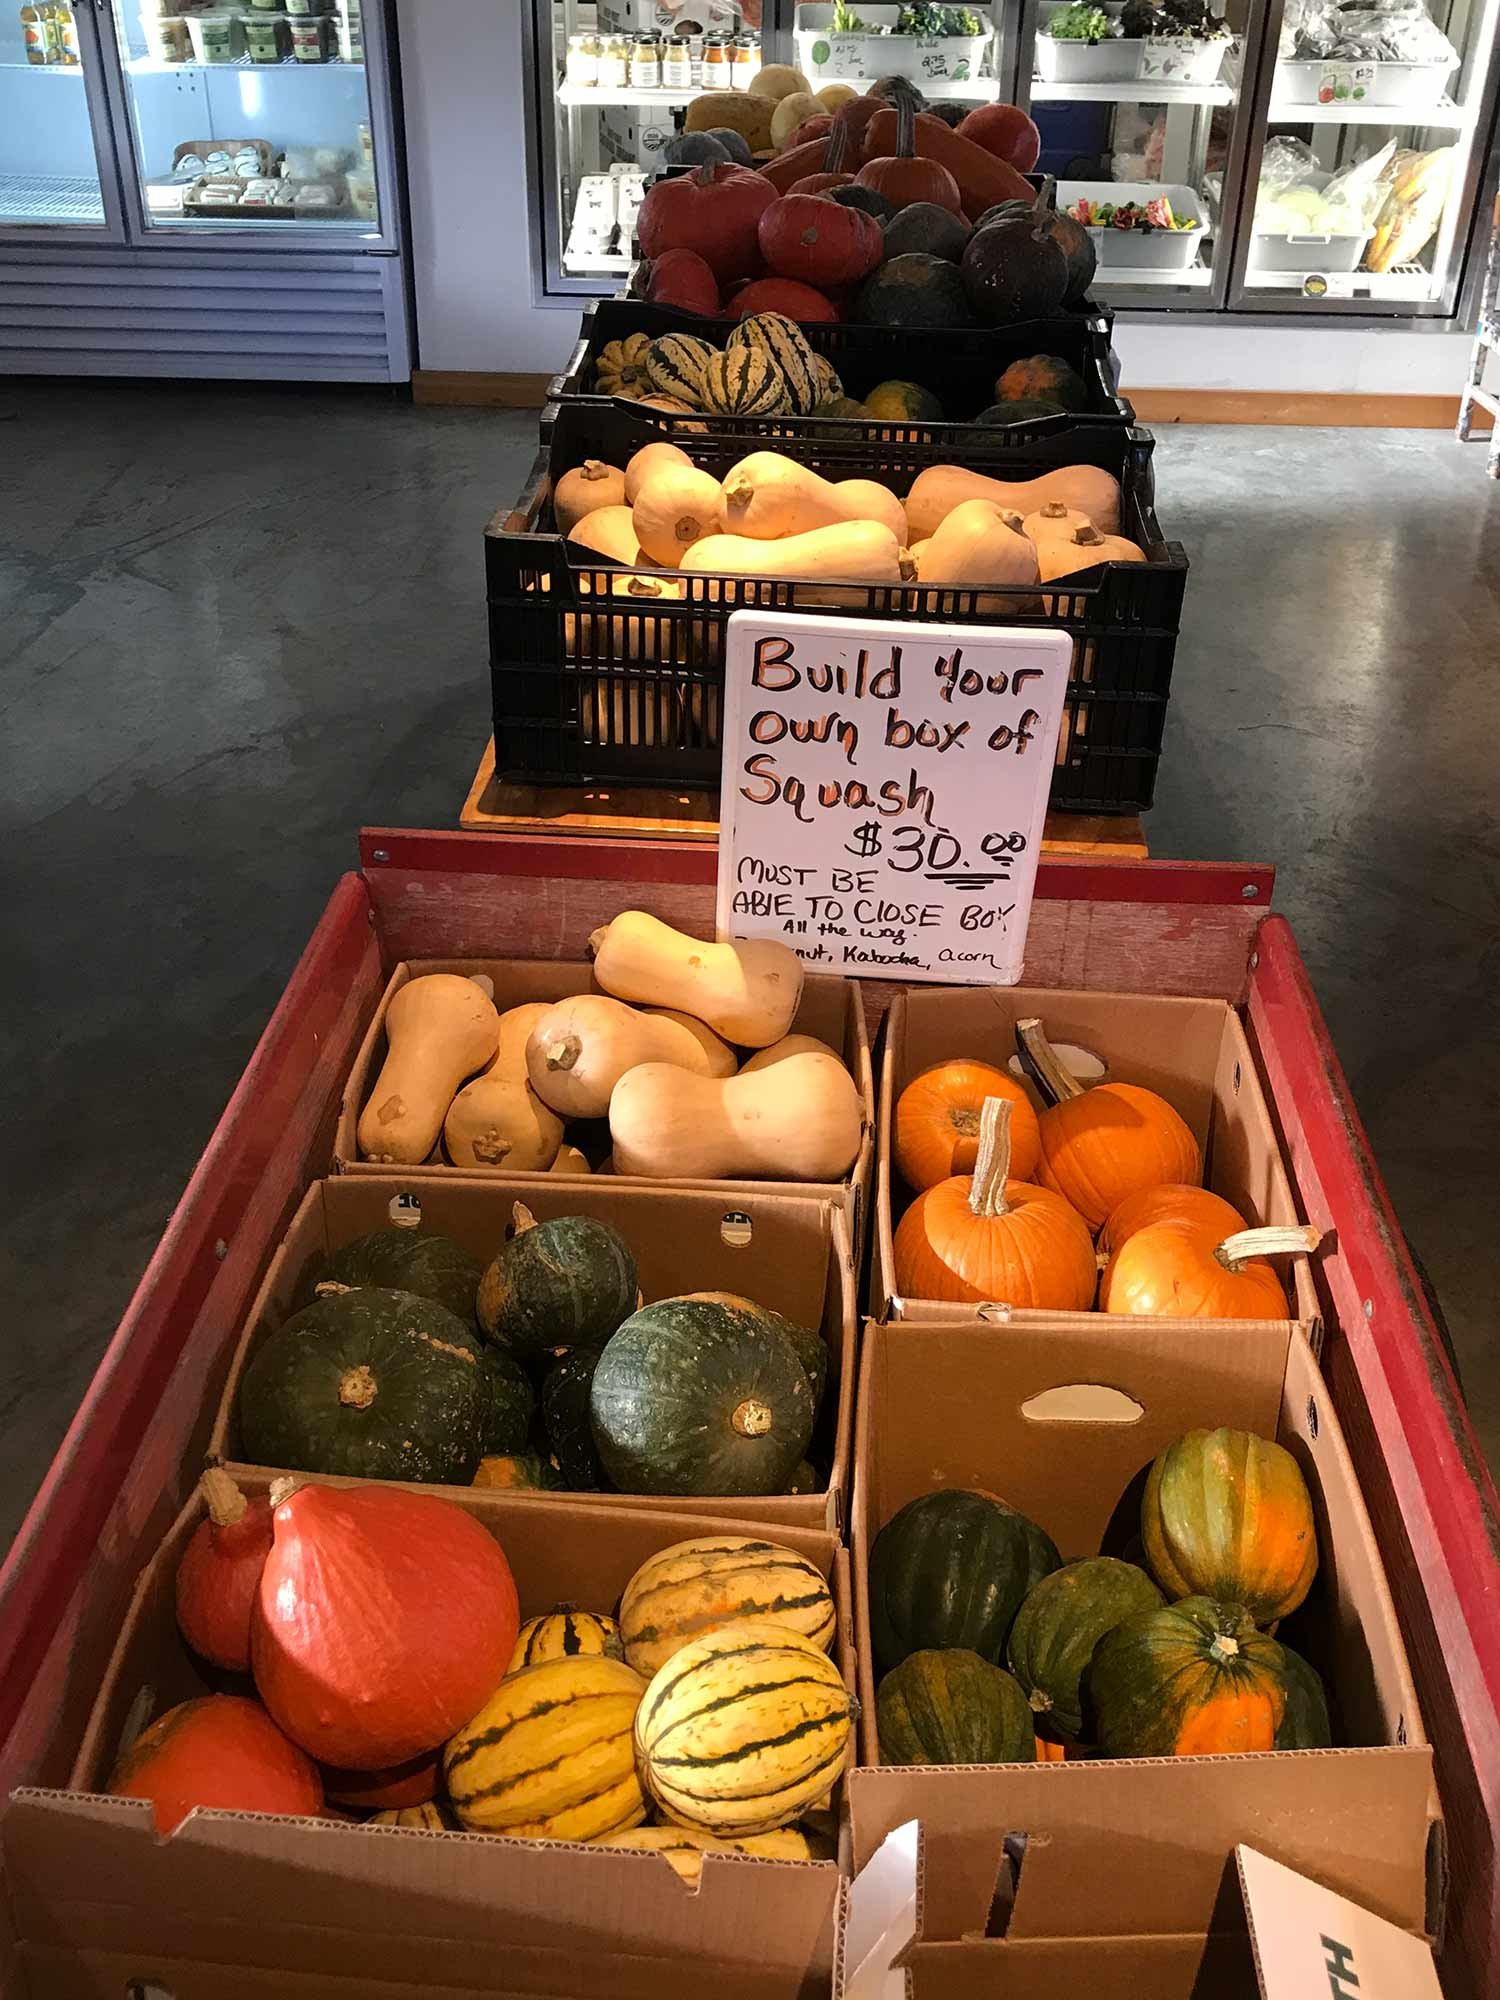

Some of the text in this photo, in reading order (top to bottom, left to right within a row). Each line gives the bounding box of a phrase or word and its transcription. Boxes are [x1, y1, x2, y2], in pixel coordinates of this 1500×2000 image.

[751, 636, 903, 699] Build
[884, 706, 972, 753] box
[987, 708, 1042, 755] of
[739, 753, 937, 828] Squash
[737, 856, 880, 893] MUST BE
[782, 919, 808, 935] All
[817, 922, 852, 938] the
[805, 895, 844, 921] TO
